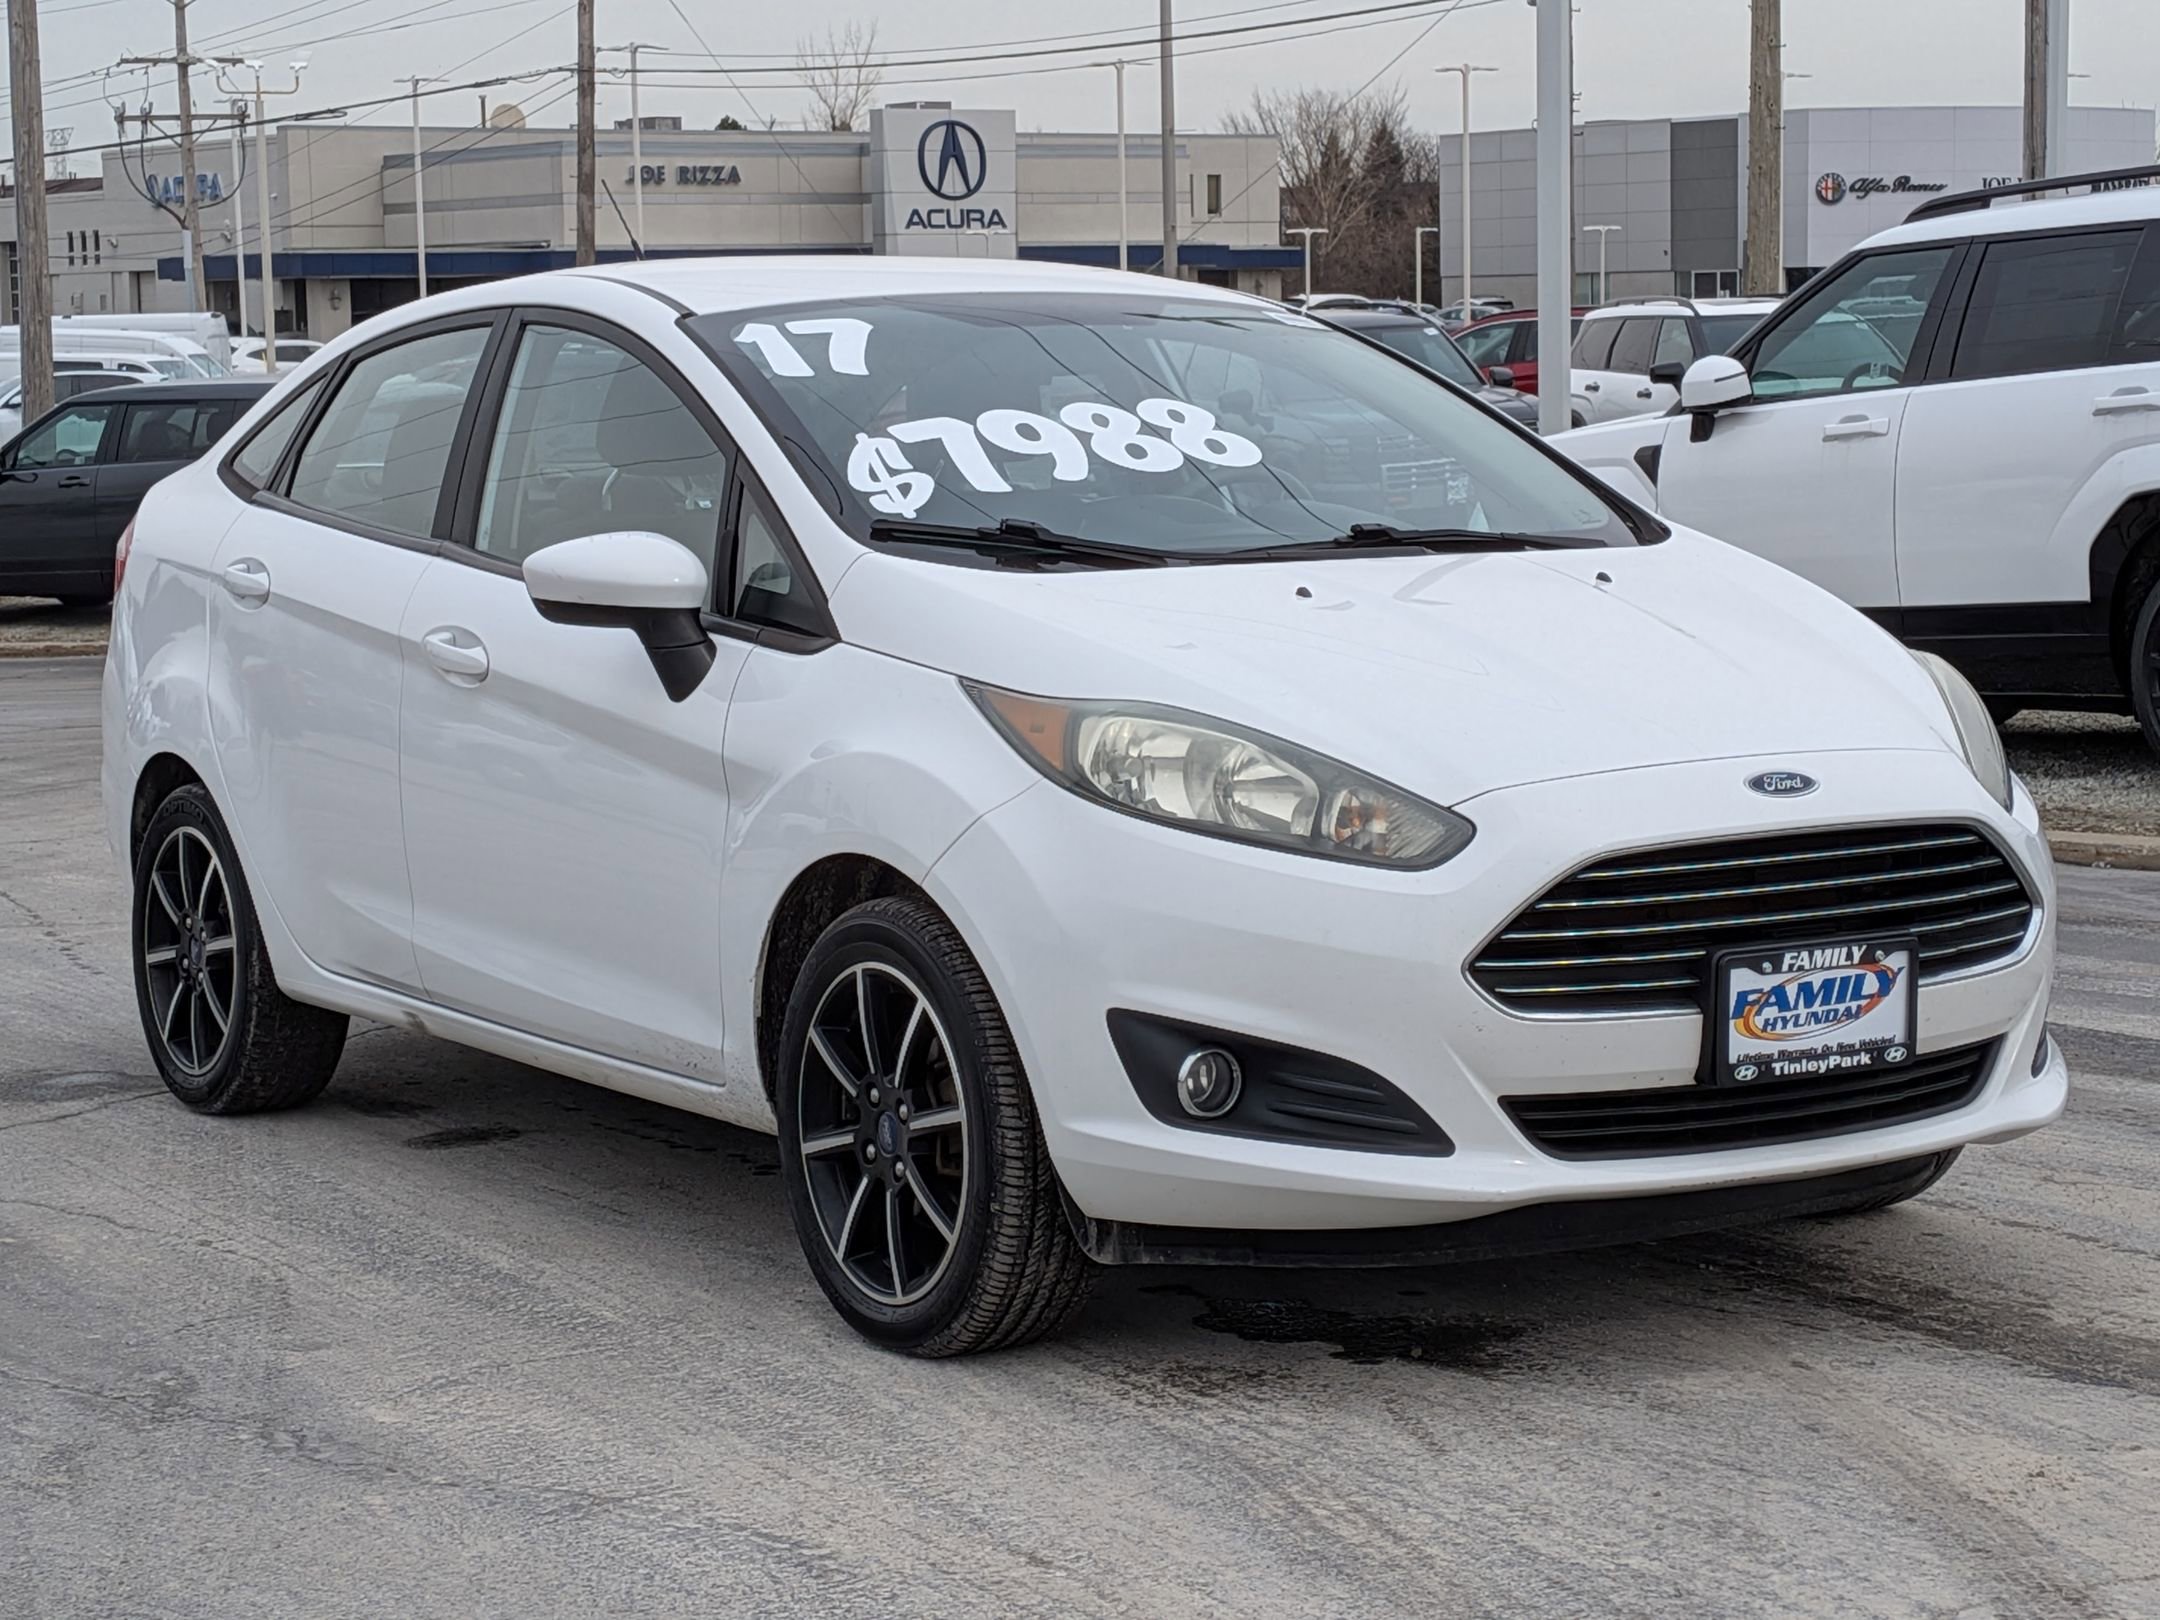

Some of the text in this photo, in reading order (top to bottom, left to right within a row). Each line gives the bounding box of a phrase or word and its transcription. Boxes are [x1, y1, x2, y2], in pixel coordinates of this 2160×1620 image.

[160, 173, 223, 204] ACRA
[625, 165, 741, 185] JOE RIZZA
[1849, 177, 1890, 200] Alfa
[1891, 175, 1947, 193] Romeo
[905, 209, 1008, 230] ACURA
[734, 318, 874, 377] 17
[847, 398, 1263, 519] $7988
[1763, 774, 1804, 791] Ford
[1781, 944, 1867, 972] FAMILY
[1730, 966, 1905, 1020] FAMILY
[1761, 1004, 1862, 1033] HYUNDAI
